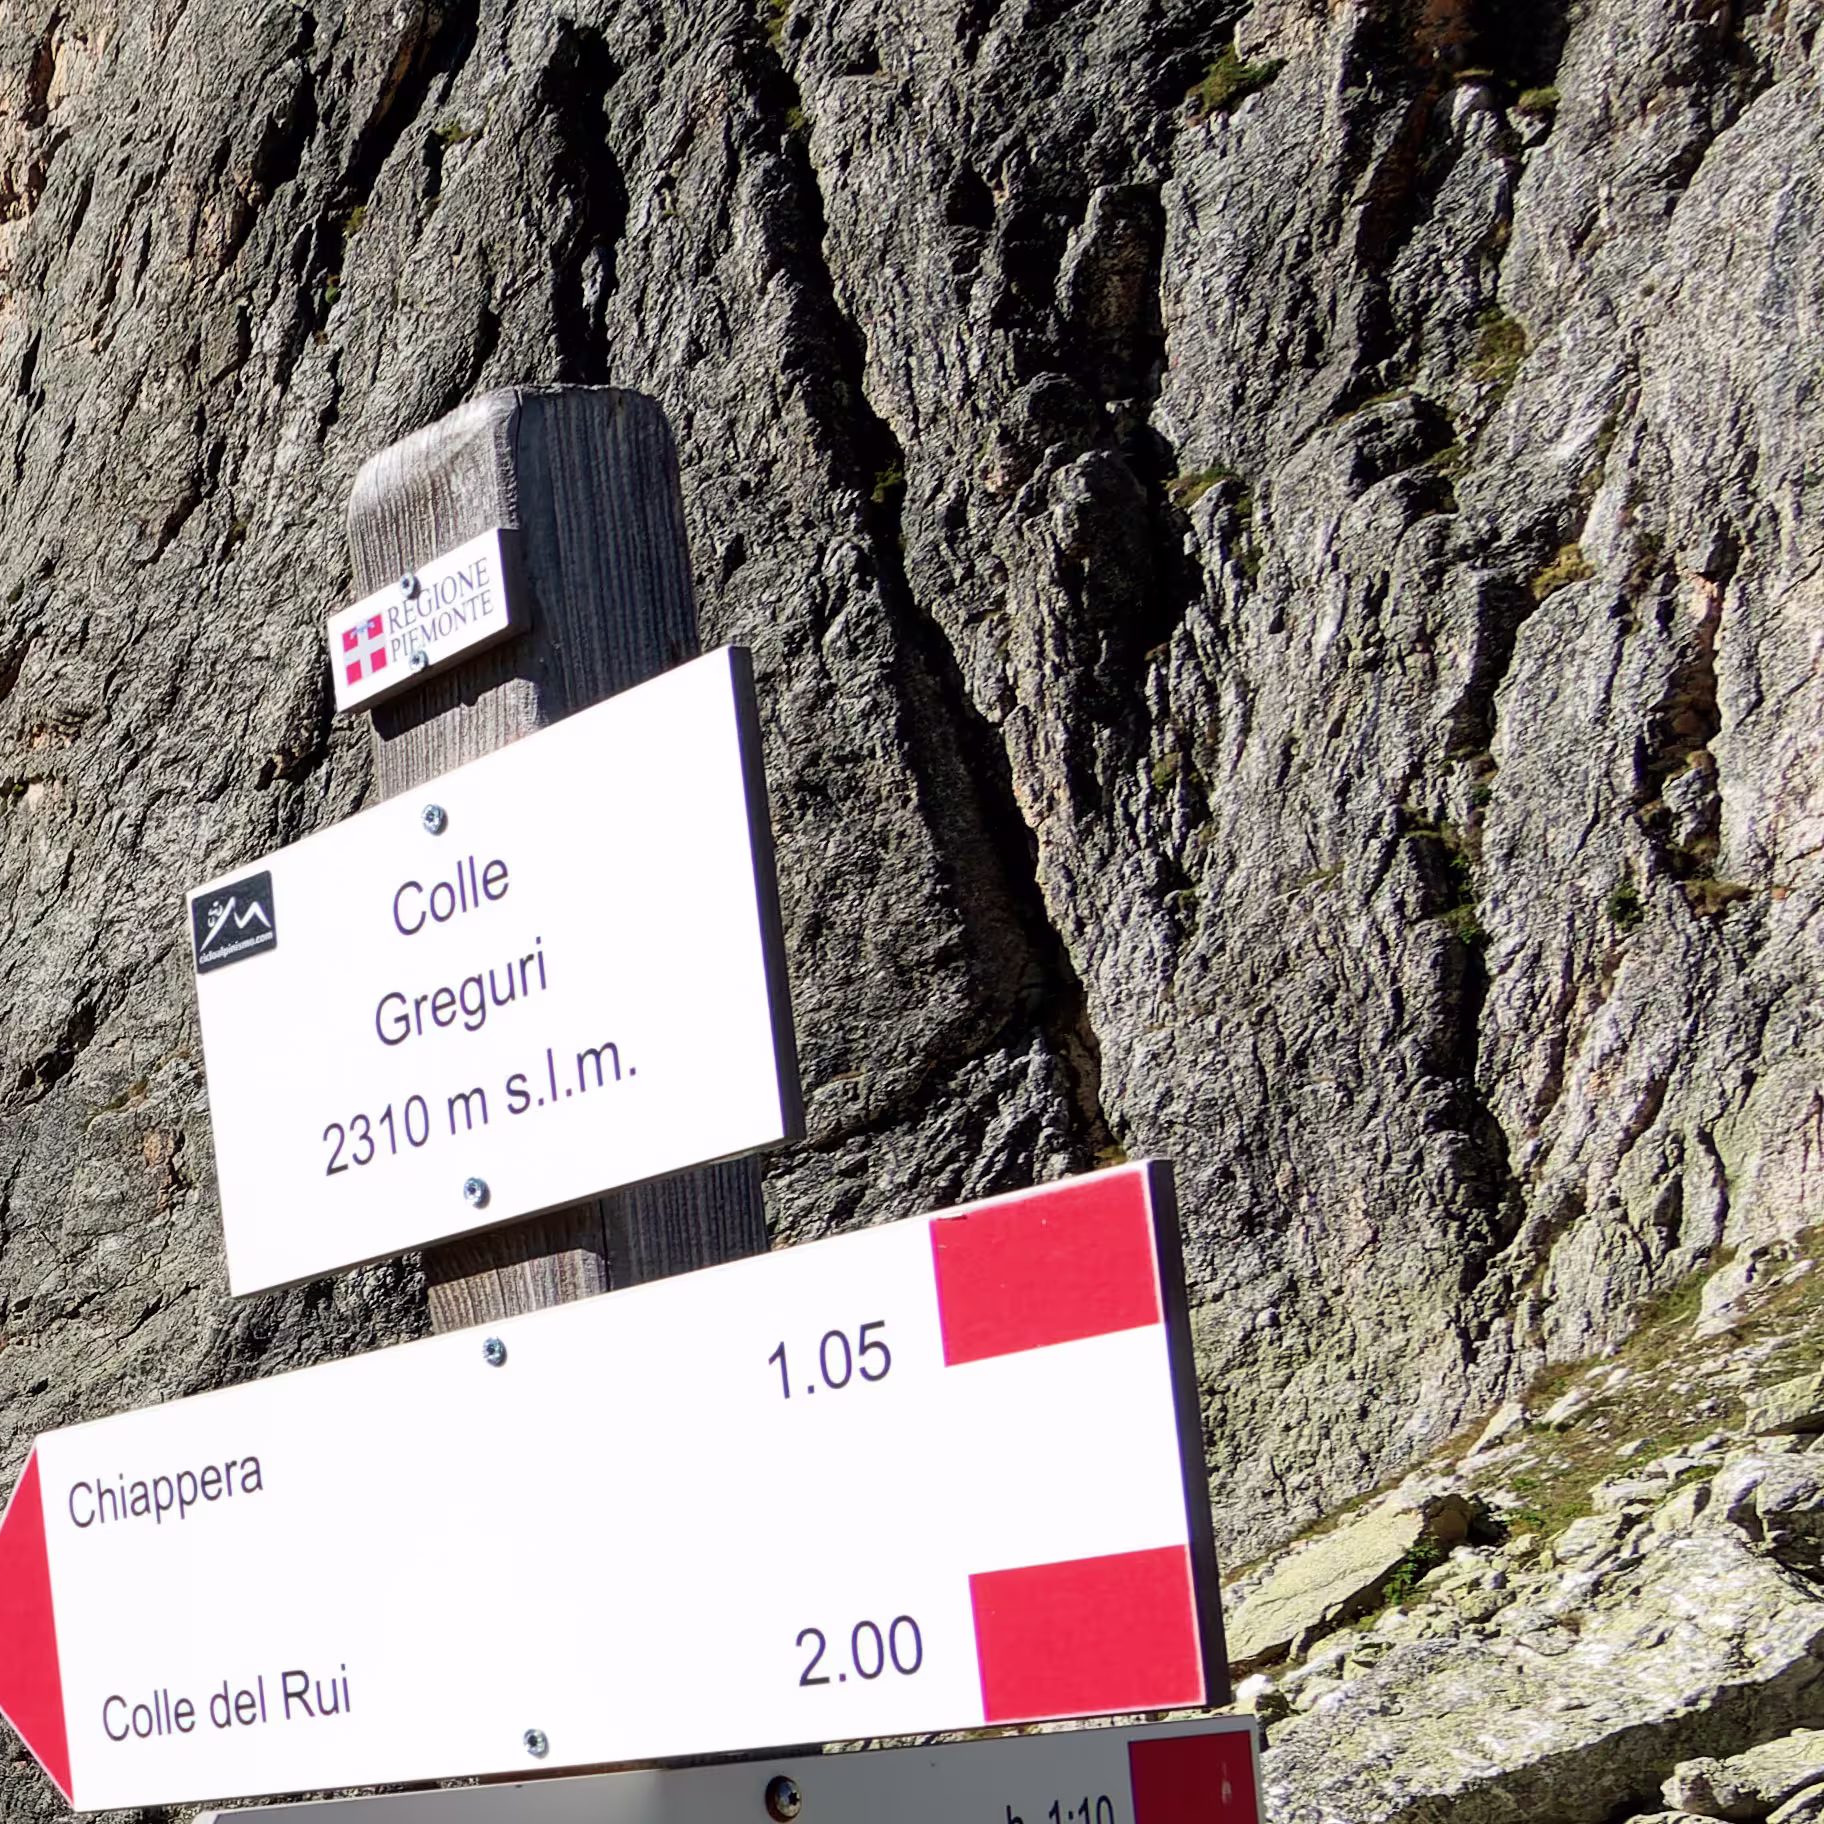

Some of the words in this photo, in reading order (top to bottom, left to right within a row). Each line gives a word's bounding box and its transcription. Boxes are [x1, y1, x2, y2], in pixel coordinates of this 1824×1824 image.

[387, 557, 491, 634] REGIONE
[391, 589, 494, 663] PIEMONTE
[394, 856, 508, 935] Colle
[376, 936, 546, 1045] Greguri
[323, 1095, 429, 1176] 2310
[448, 1088, 488, 1134] m
[506, 1042, 636, 1114] s.l.m.
[769, 1320, 891, 1399] 1.05
[69, 1457, 263, 1528] Chiappera
[796, 1615, 922, 1686] 2.00
[103, 1689, 195, 1741] Colle
[210, 1676, 266, 1728] del
[282, 1664, 350, 1720] Rui
